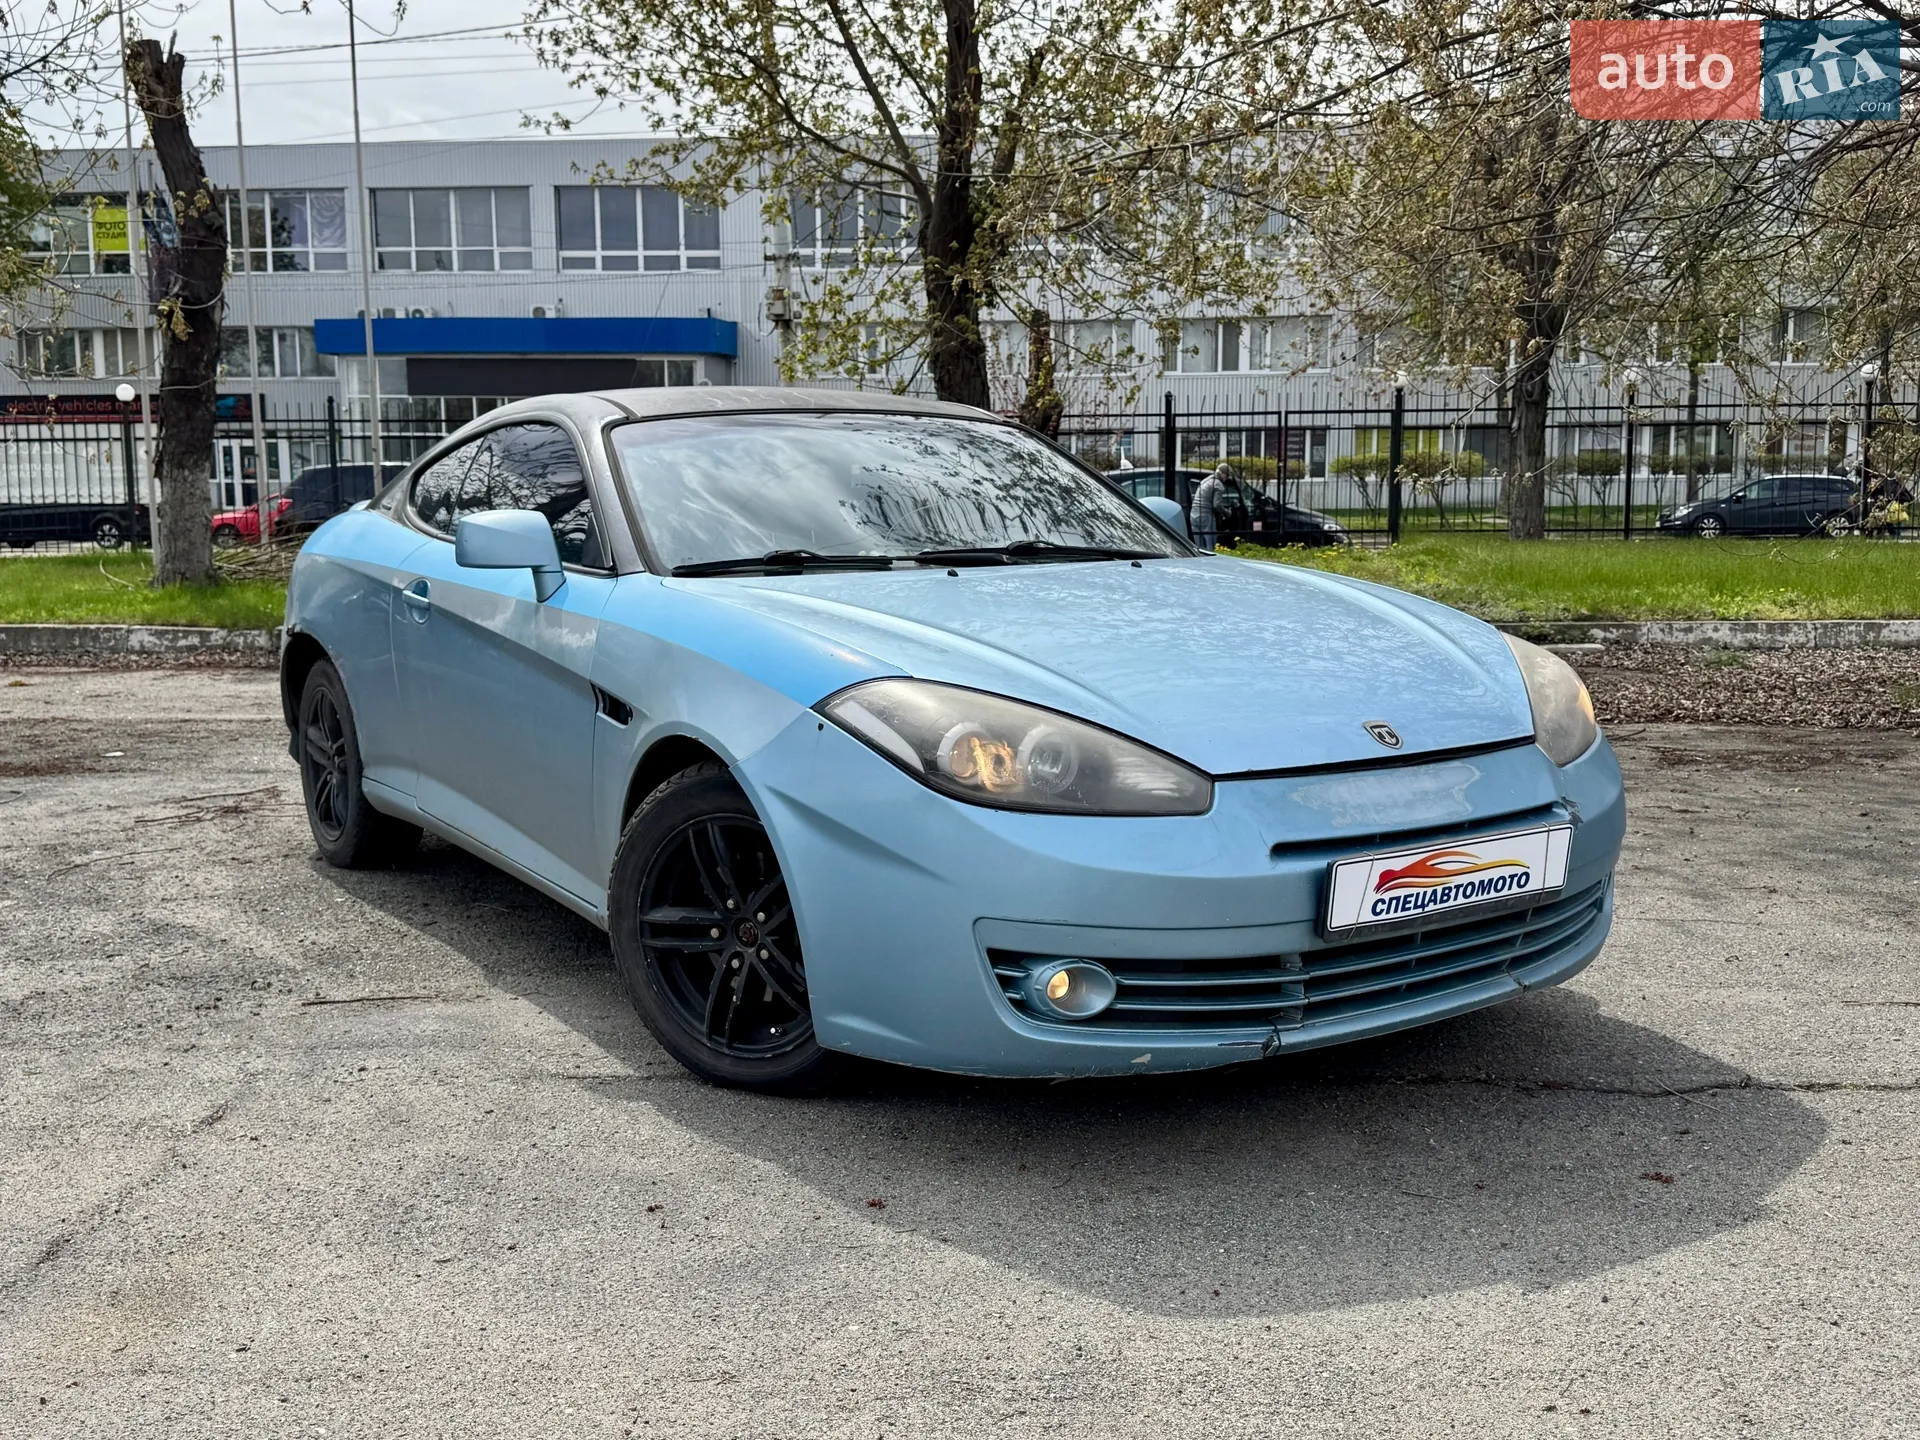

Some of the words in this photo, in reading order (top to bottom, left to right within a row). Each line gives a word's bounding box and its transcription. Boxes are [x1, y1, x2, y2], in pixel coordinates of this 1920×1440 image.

[95, 221, 126, 231] ФОТО
[57, 399, 112, 412] vehicles
[1371, 871, 1531, 917] СПЕЦАВТОМОТО
